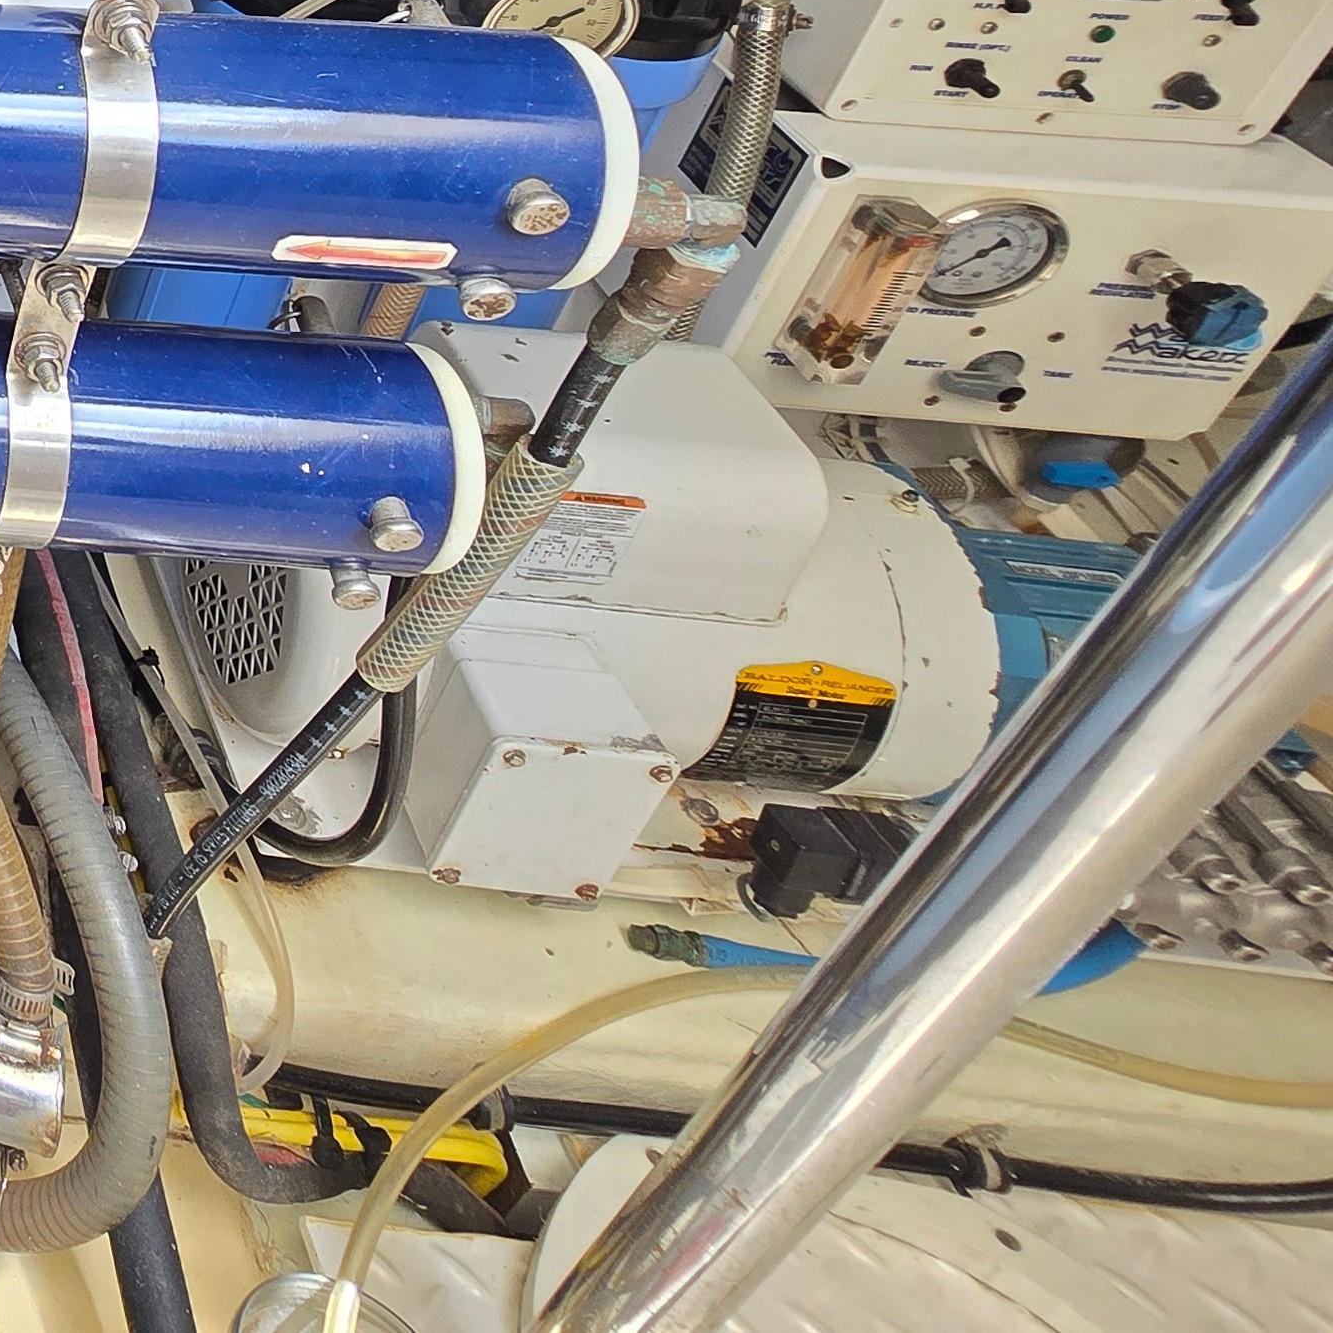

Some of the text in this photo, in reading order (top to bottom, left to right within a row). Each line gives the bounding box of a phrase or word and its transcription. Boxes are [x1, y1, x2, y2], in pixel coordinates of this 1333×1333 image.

[1089, 13, 1130, 21] POWER
[933, 89, 969, 98] START
[920, 308, 977, 318] PRESSURE
[904, 359, 947, 369] REJECT
[743, 672, 812, 686] BALDOR
